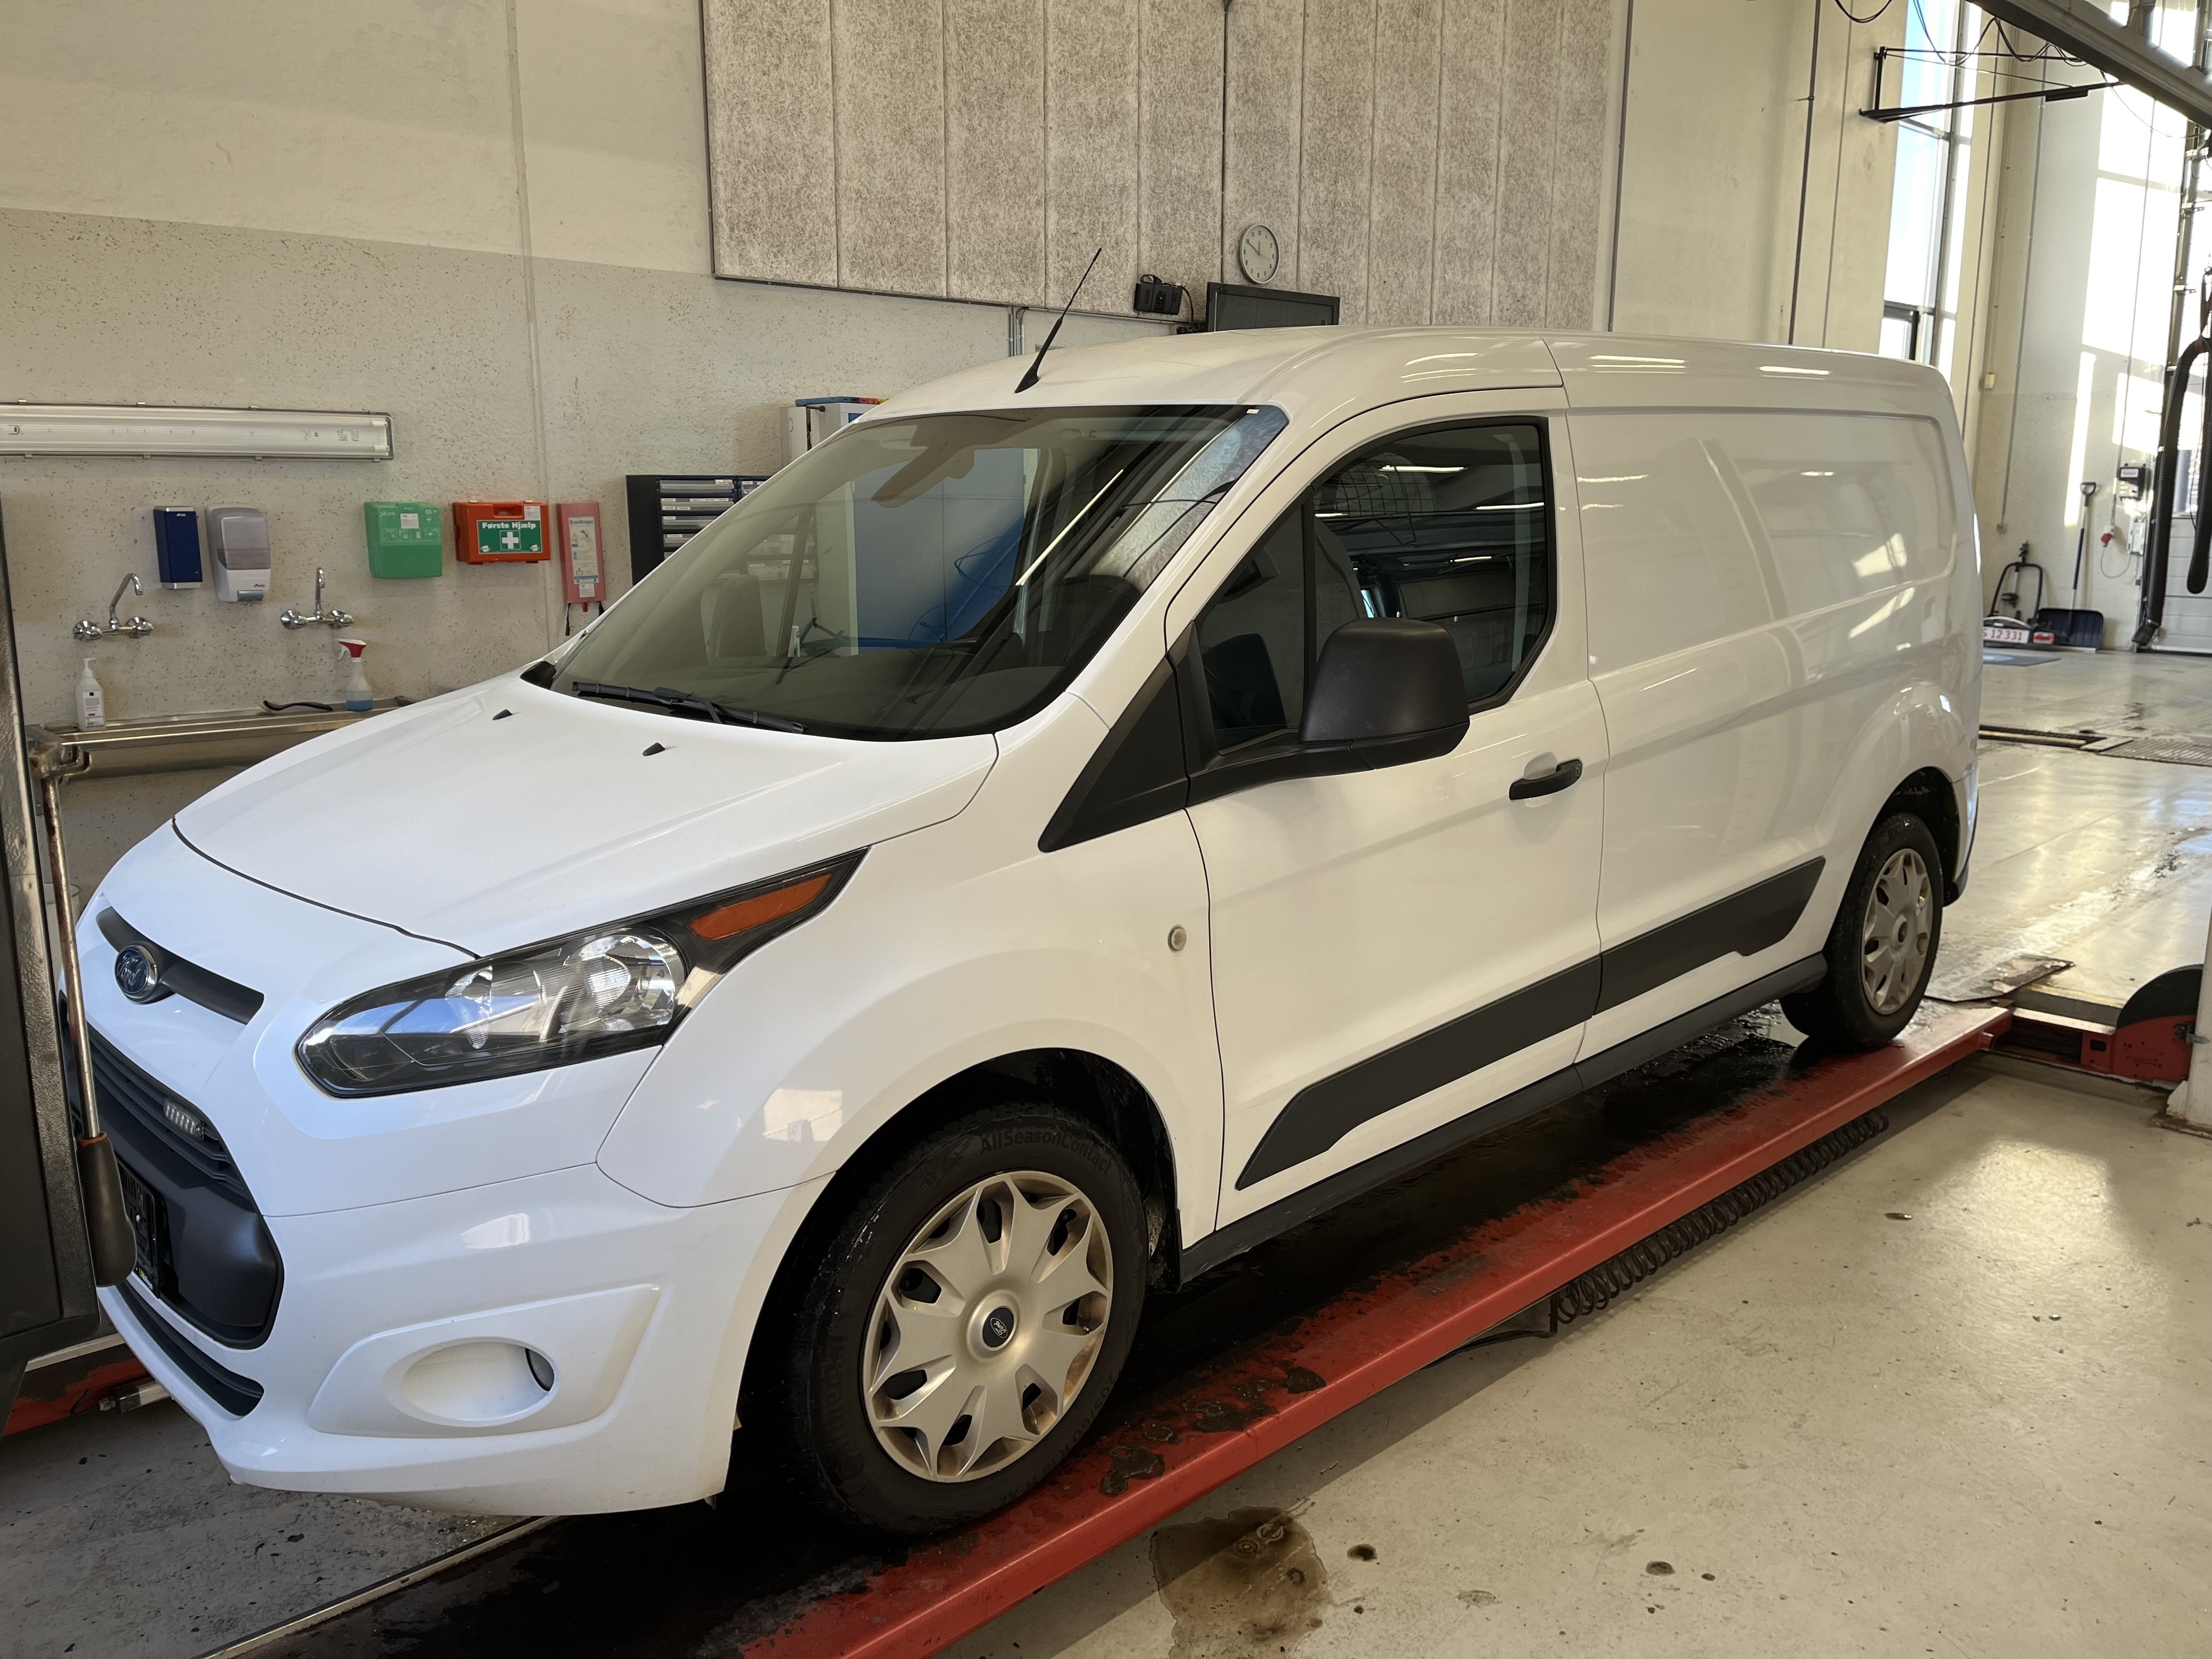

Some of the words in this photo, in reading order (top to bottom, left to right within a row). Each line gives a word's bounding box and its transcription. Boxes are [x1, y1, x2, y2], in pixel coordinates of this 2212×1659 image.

[1991, 629, 2003, 639] 12
[2005, 630, 2022, 641] 331
[116, 952, 140, 986] Ford
[980, 1127, 1114, 1176] AllSeasonContact
[994, 1321, 1006, 1335] Ford
